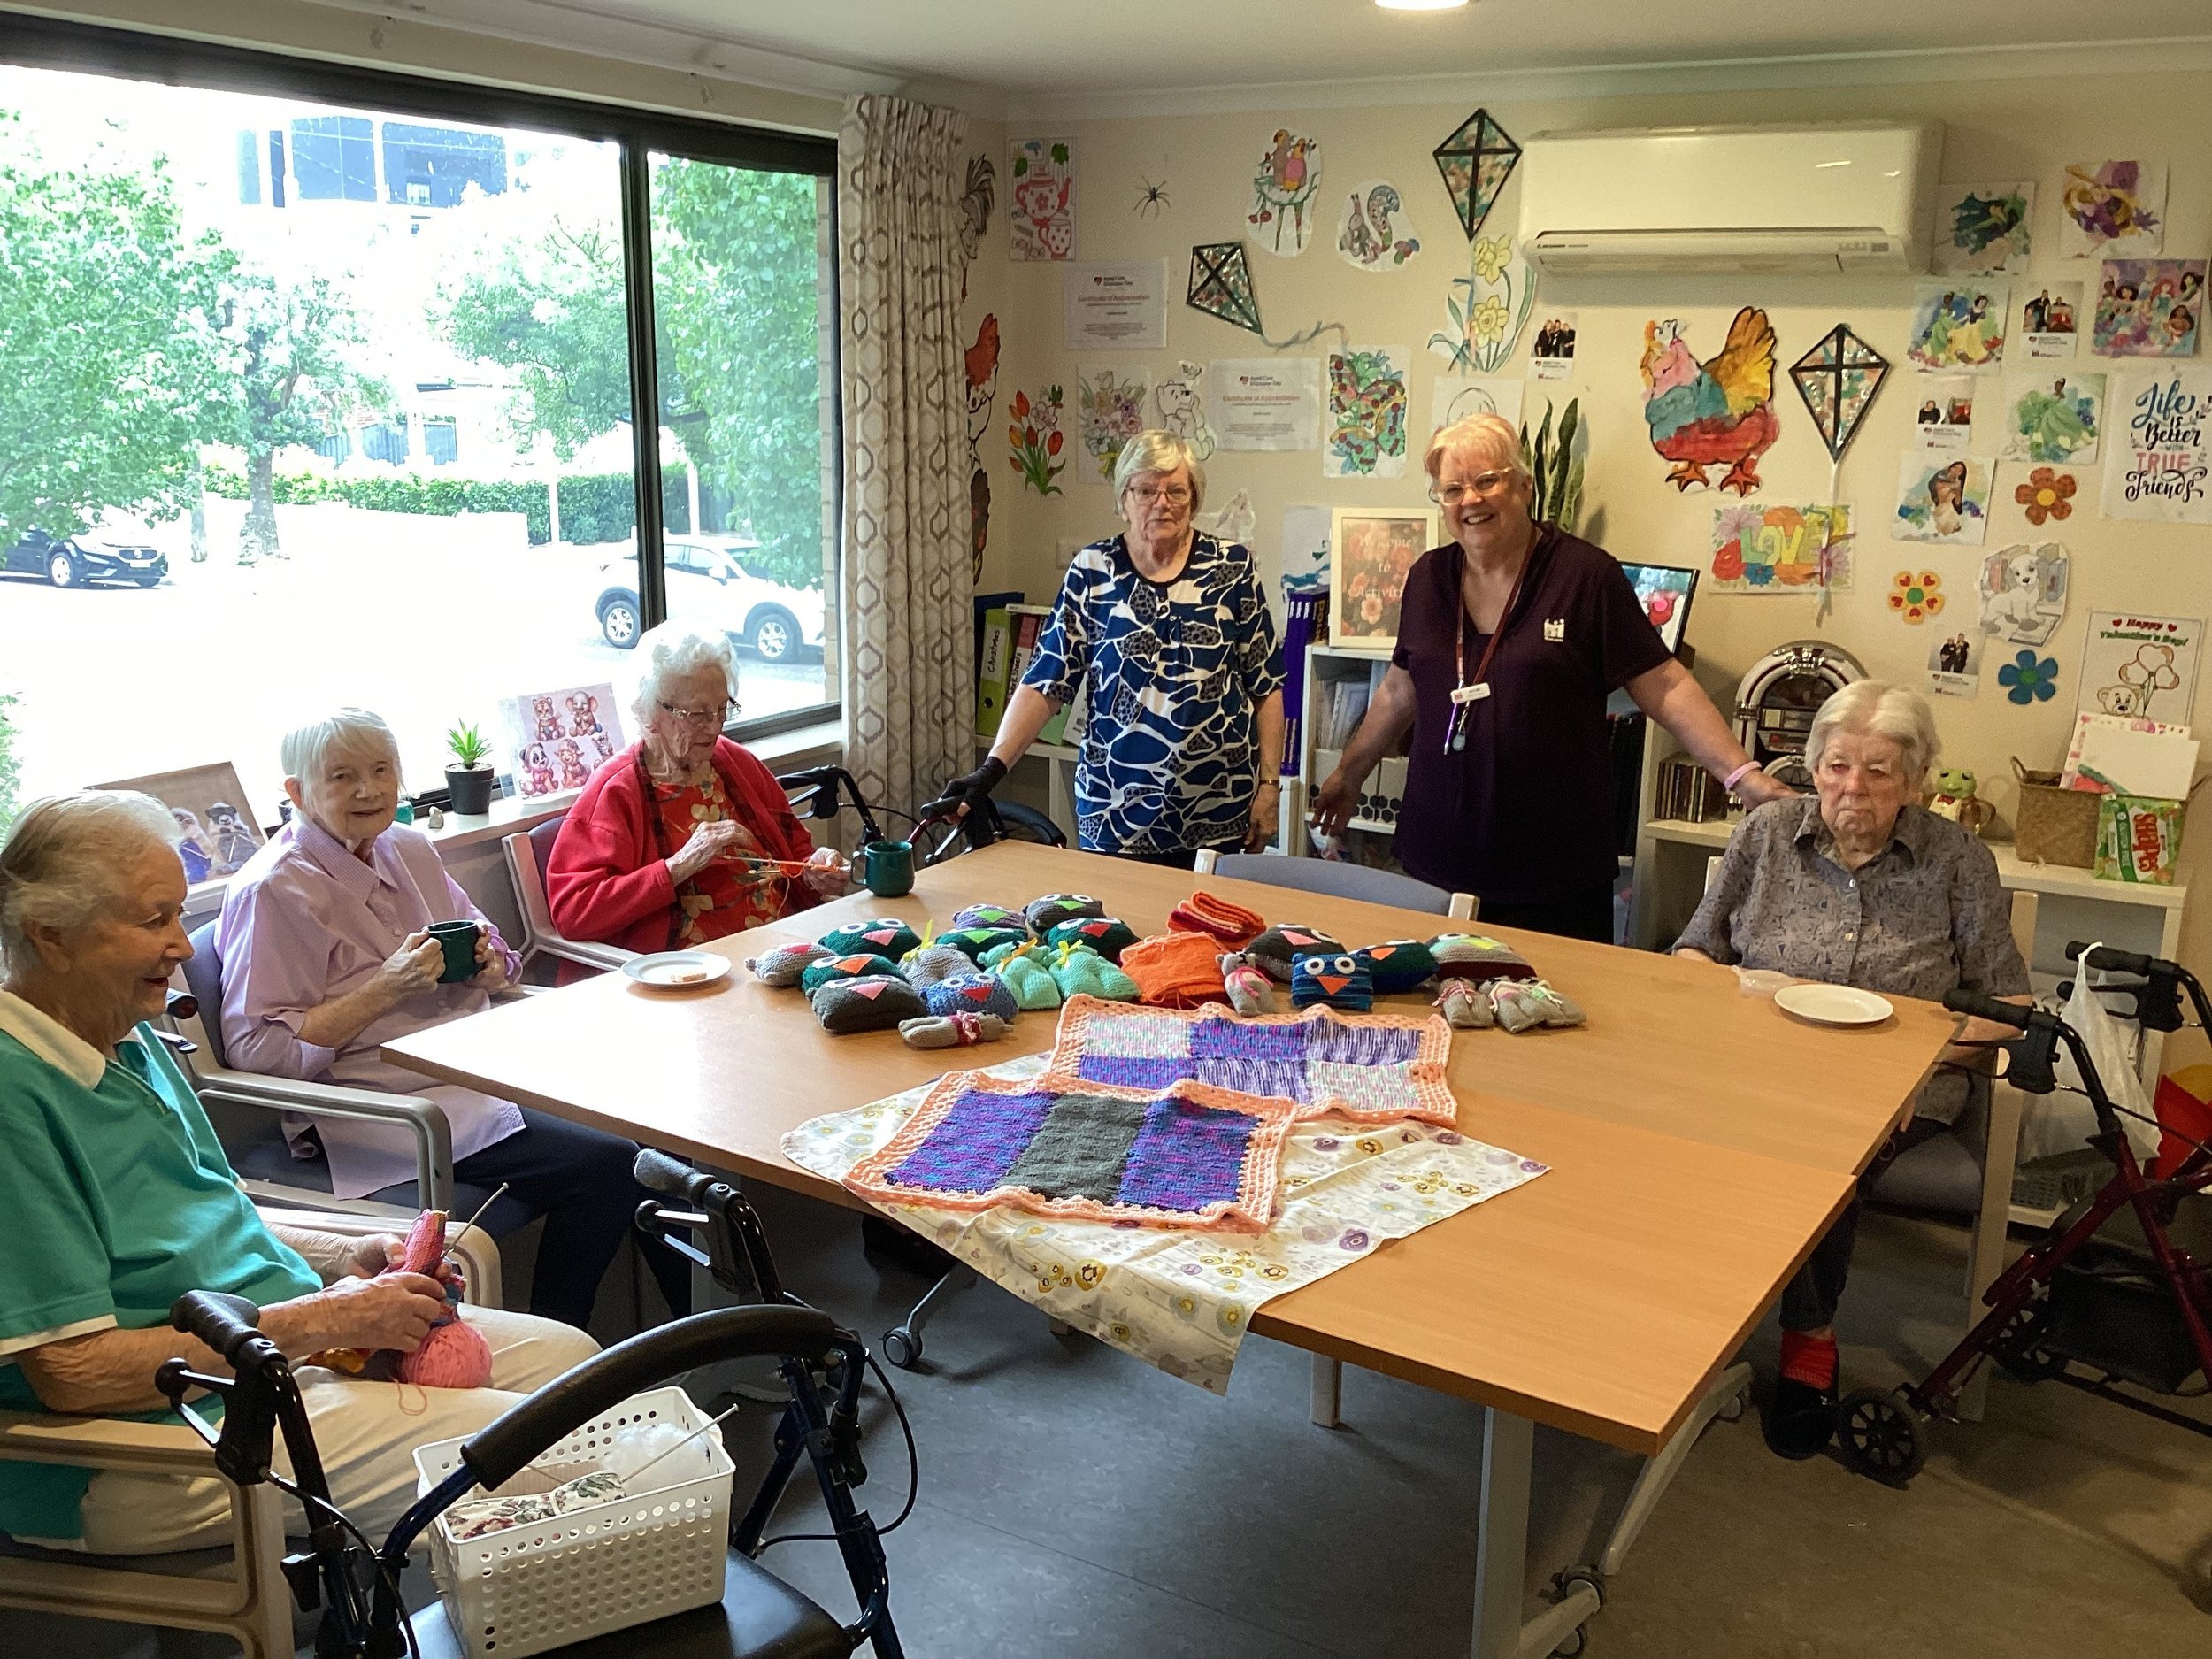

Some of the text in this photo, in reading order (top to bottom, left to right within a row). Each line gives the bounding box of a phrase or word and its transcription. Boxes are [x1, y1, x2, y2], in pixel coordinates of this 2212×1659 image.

[2131, 380, 2195, 428] Life
[2145, 422, 2201, 450] Better
[2136, 452, 2191, 475] TRUE
[2125, 466, 2208, 503] Friends
[1740, 525, 1820, 565] LOVE
[1379, 561, 1391, 572] to
[2126, 618, 2164, 631] Happy
[2100, 630, 2189, 647] Valentine's Day!
